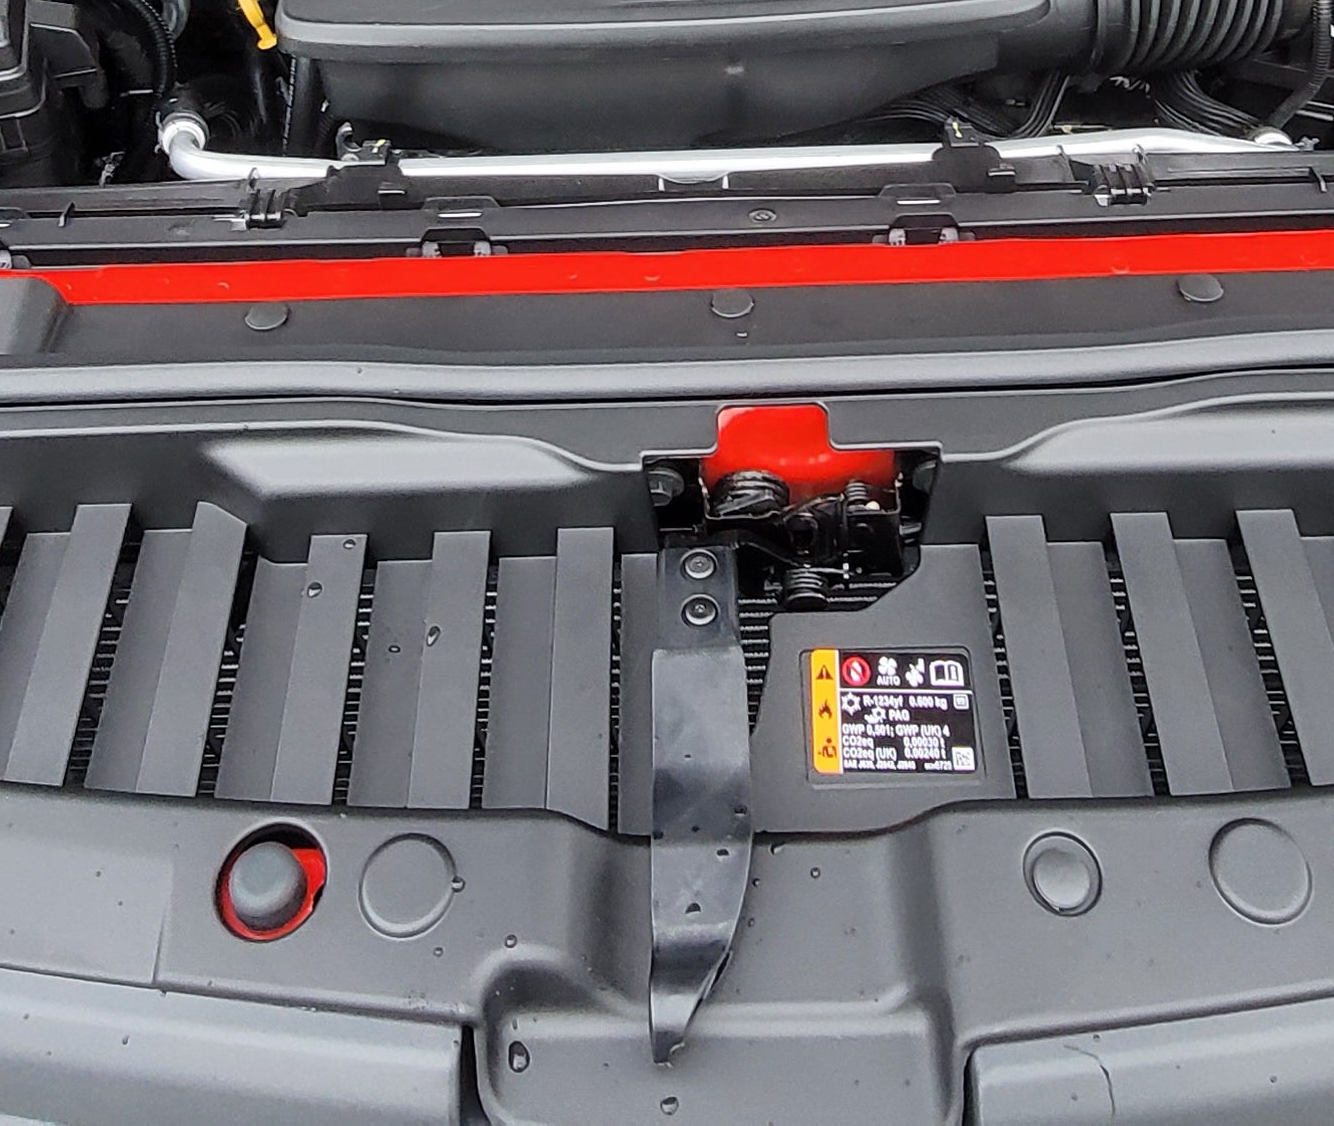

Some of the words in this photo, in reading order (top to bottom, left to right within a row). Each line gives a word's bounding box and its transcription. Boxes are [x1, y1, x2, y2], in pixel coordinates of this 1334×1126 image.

[876, 675, 901, 686] AUTO
[862, 695, 903, 709] R-1234yf
[934, 696, 948, 711] kg
[842, 723, 865, 735] GWP
[895, 724, 919, 736] GWP
[920, 724, 942, 739] (UK)
[842, 735, 874, 749] CO2eq
[843, 747, 875, 761] CO2eq
[875, 747, 897, 761] (UK)
